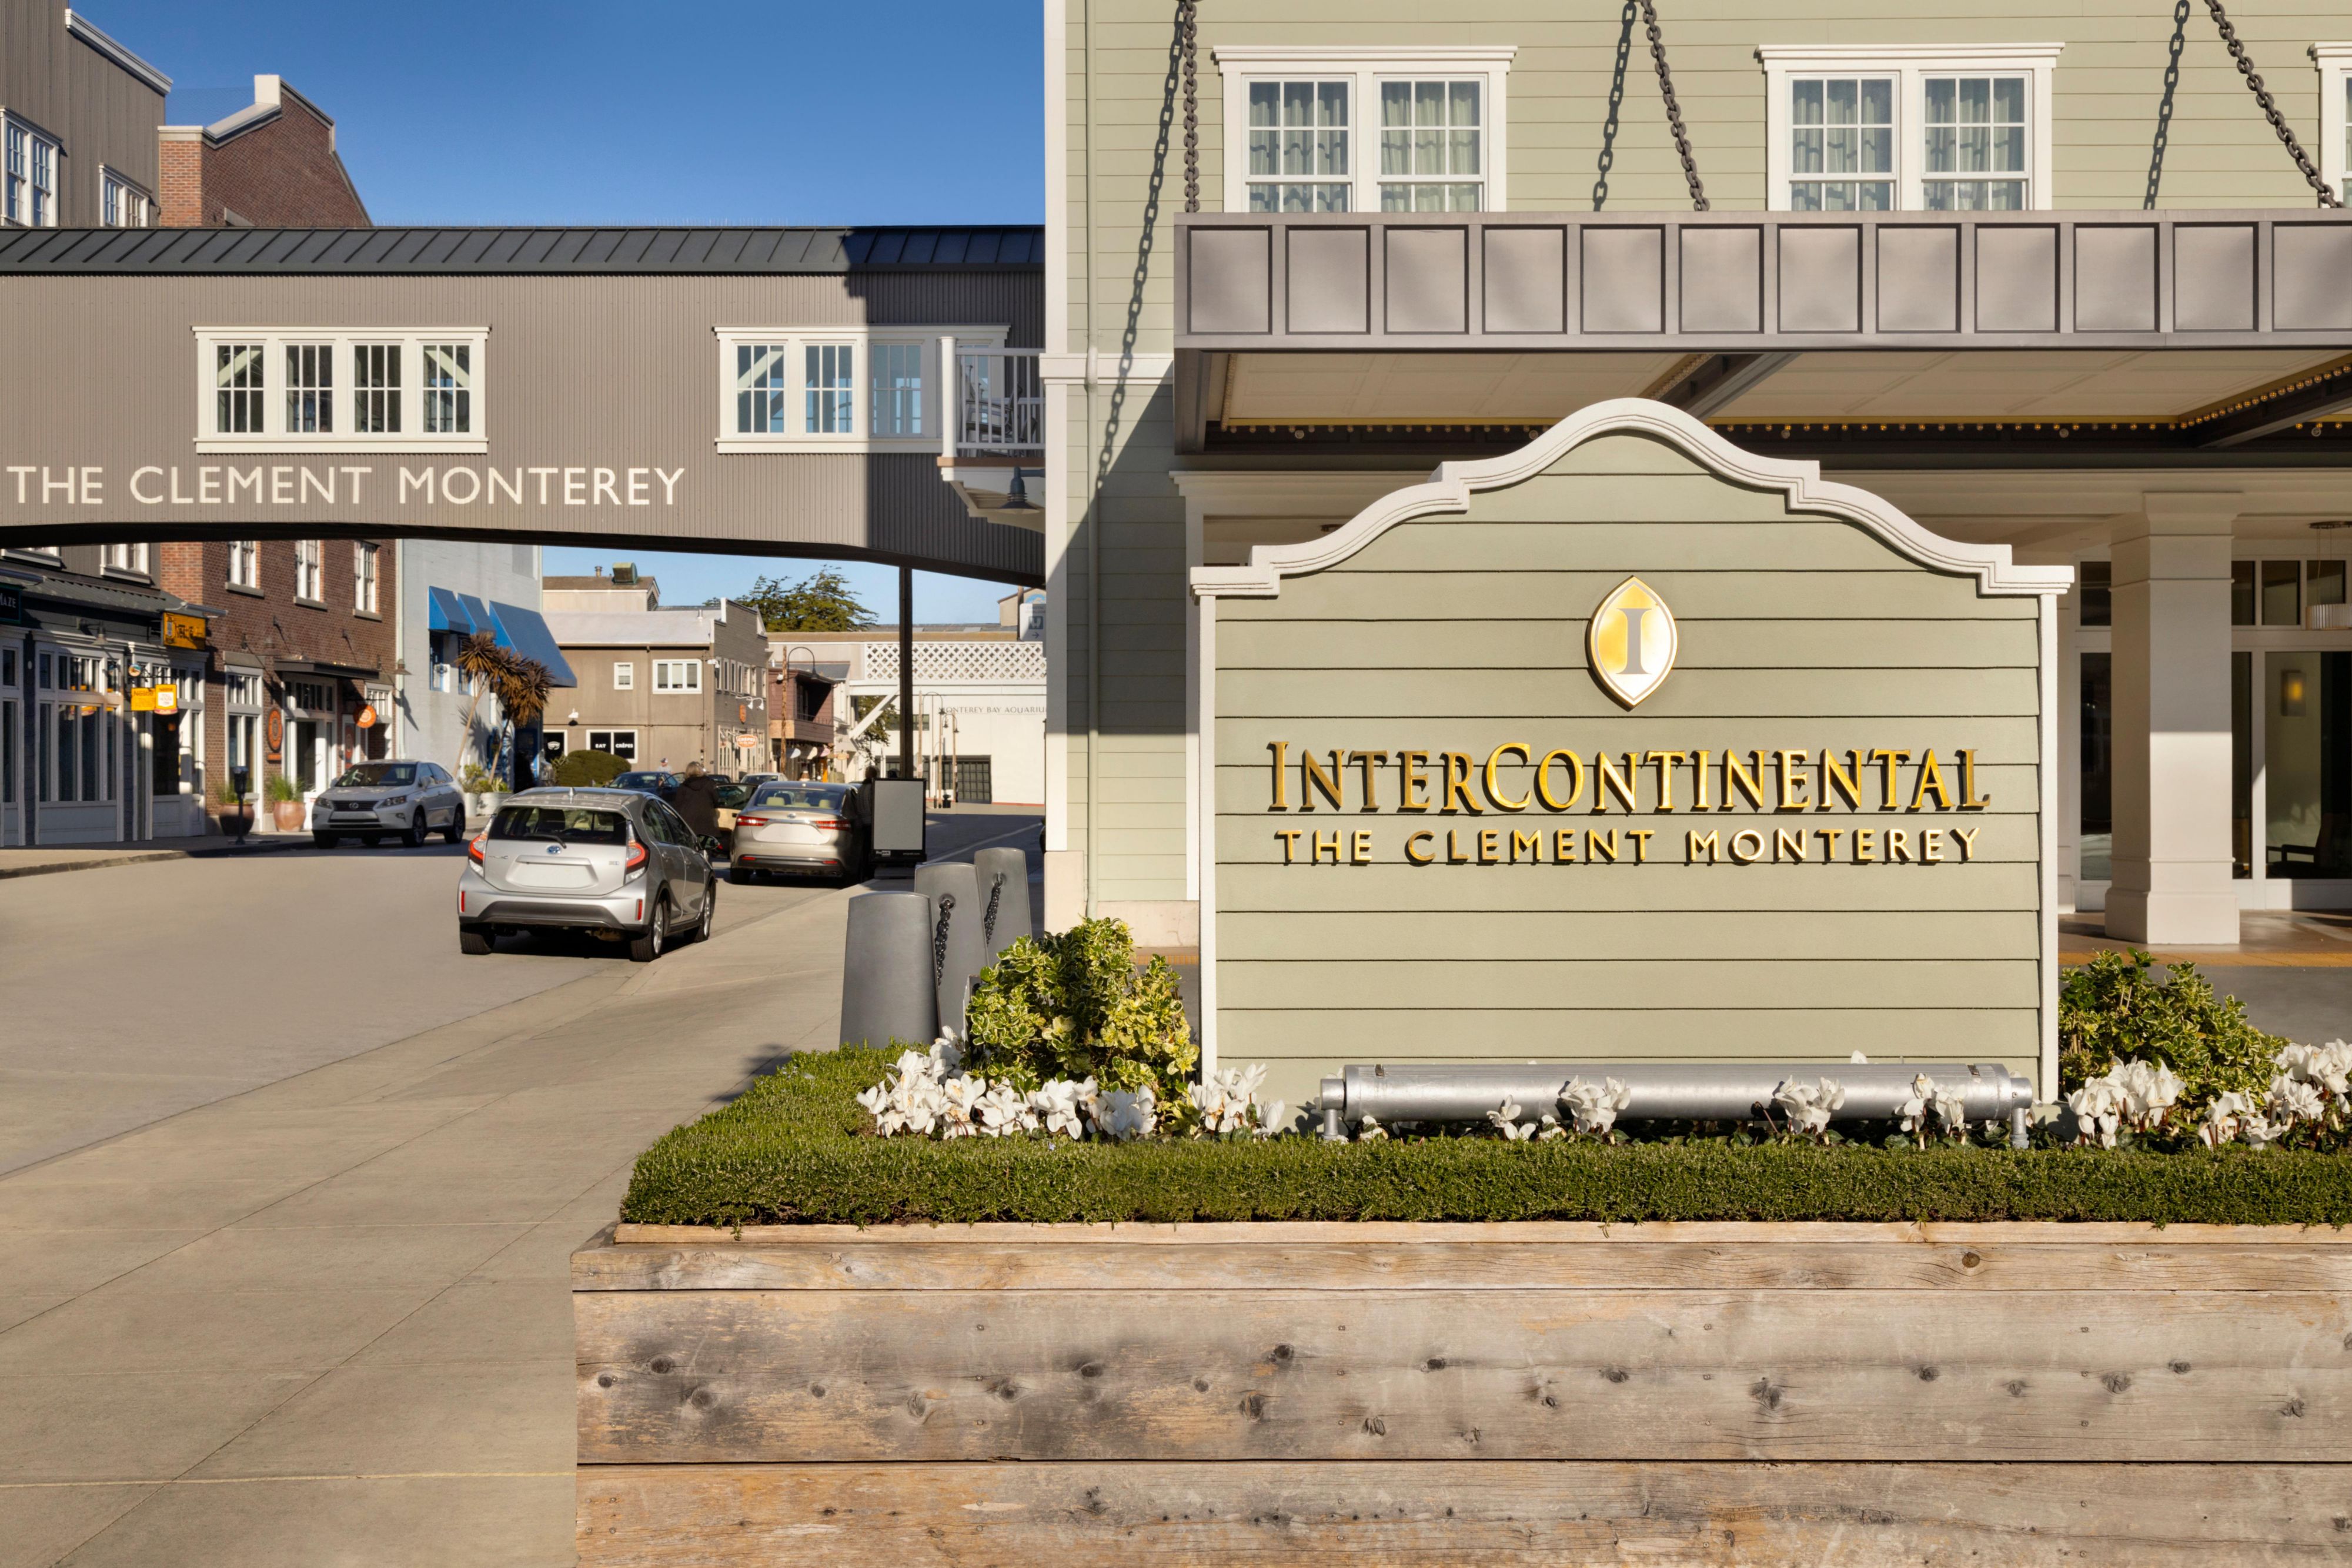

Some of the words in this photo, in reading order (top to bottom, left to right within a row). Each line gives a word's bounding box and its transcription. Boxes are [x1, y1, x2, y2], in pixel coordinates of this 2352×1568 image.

[6, 466, 103, 504] THE
[130, 466, 372, 504] CLEMENT
[399, 467, 685, 505] MONTEREY
[1275, 829, 1372, 863] THE
[1405, 828, 1655, 863] CLEMENT
[1686, 827, 1980, 862] MONTEREY
